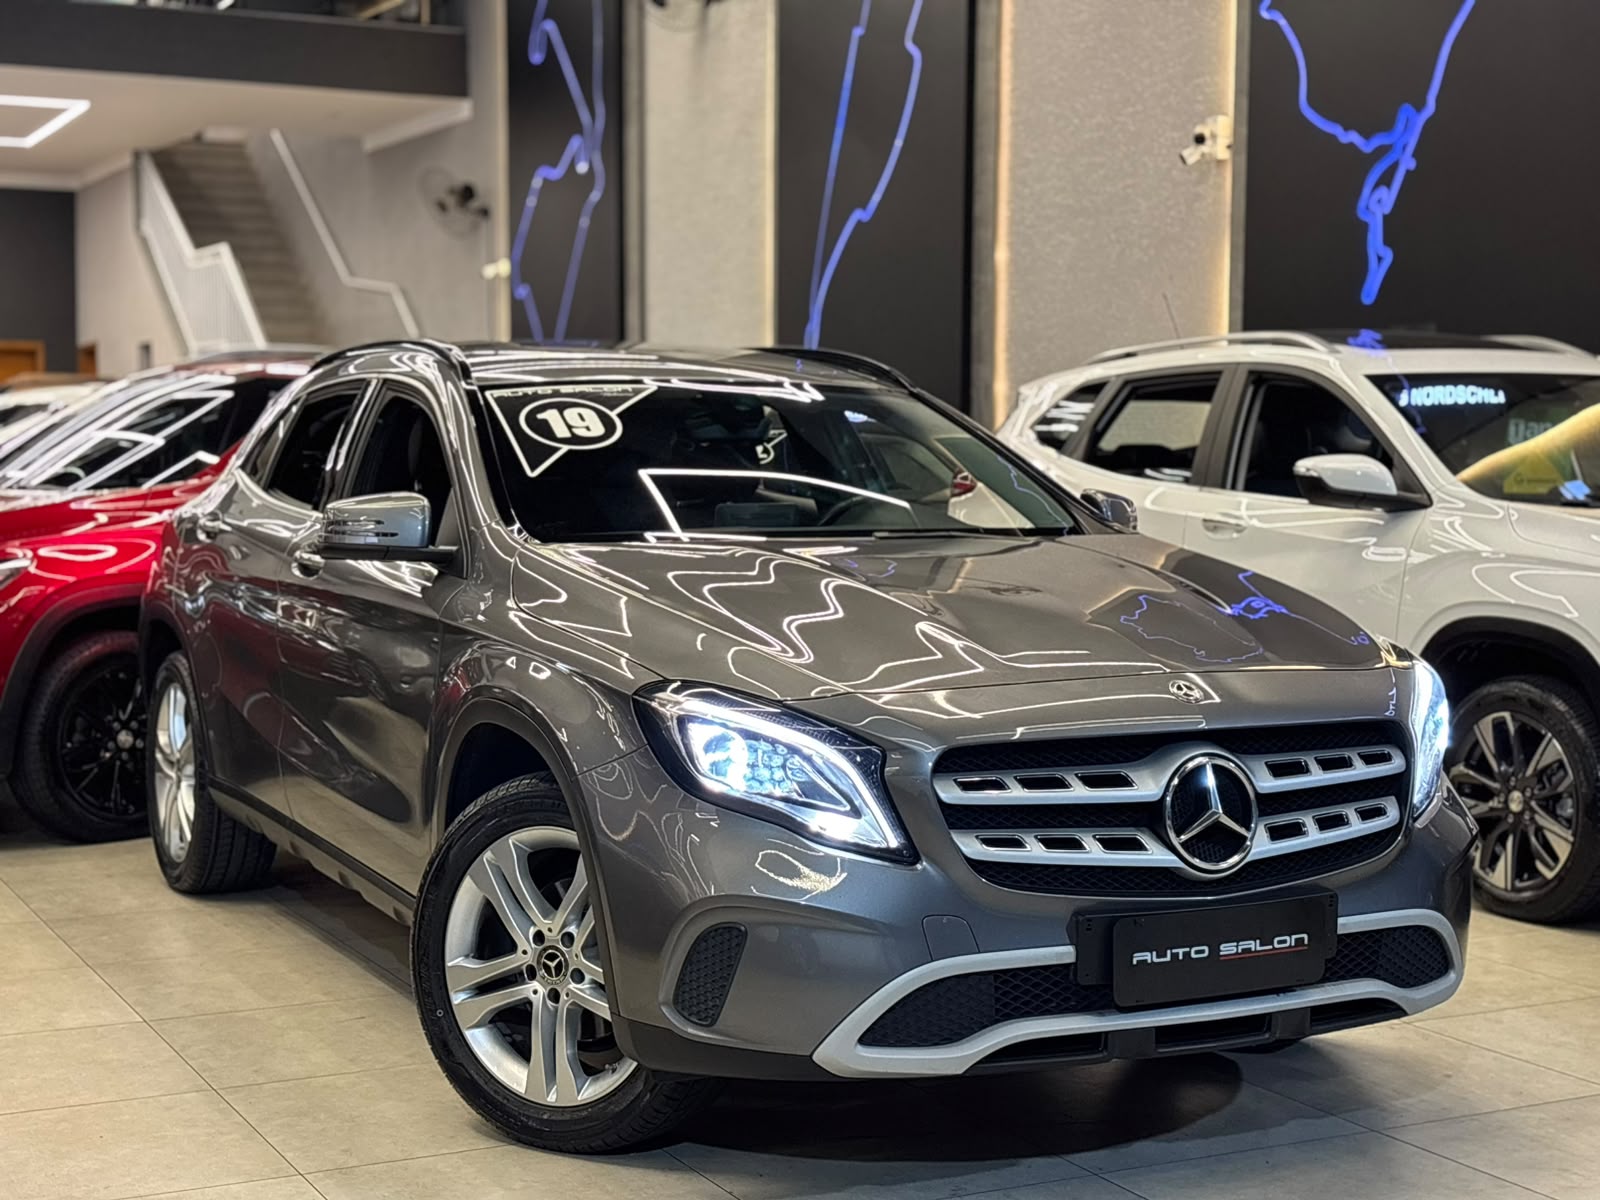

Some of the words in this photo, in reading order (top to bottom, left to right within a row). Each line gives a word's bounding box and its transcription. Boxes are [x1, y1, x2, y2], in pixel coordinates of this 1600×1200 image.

[536, 407, 606, 438] 19
[1132, 945, 1209, 965] AUTO
[1219, 933, 1309, 956] SALON
